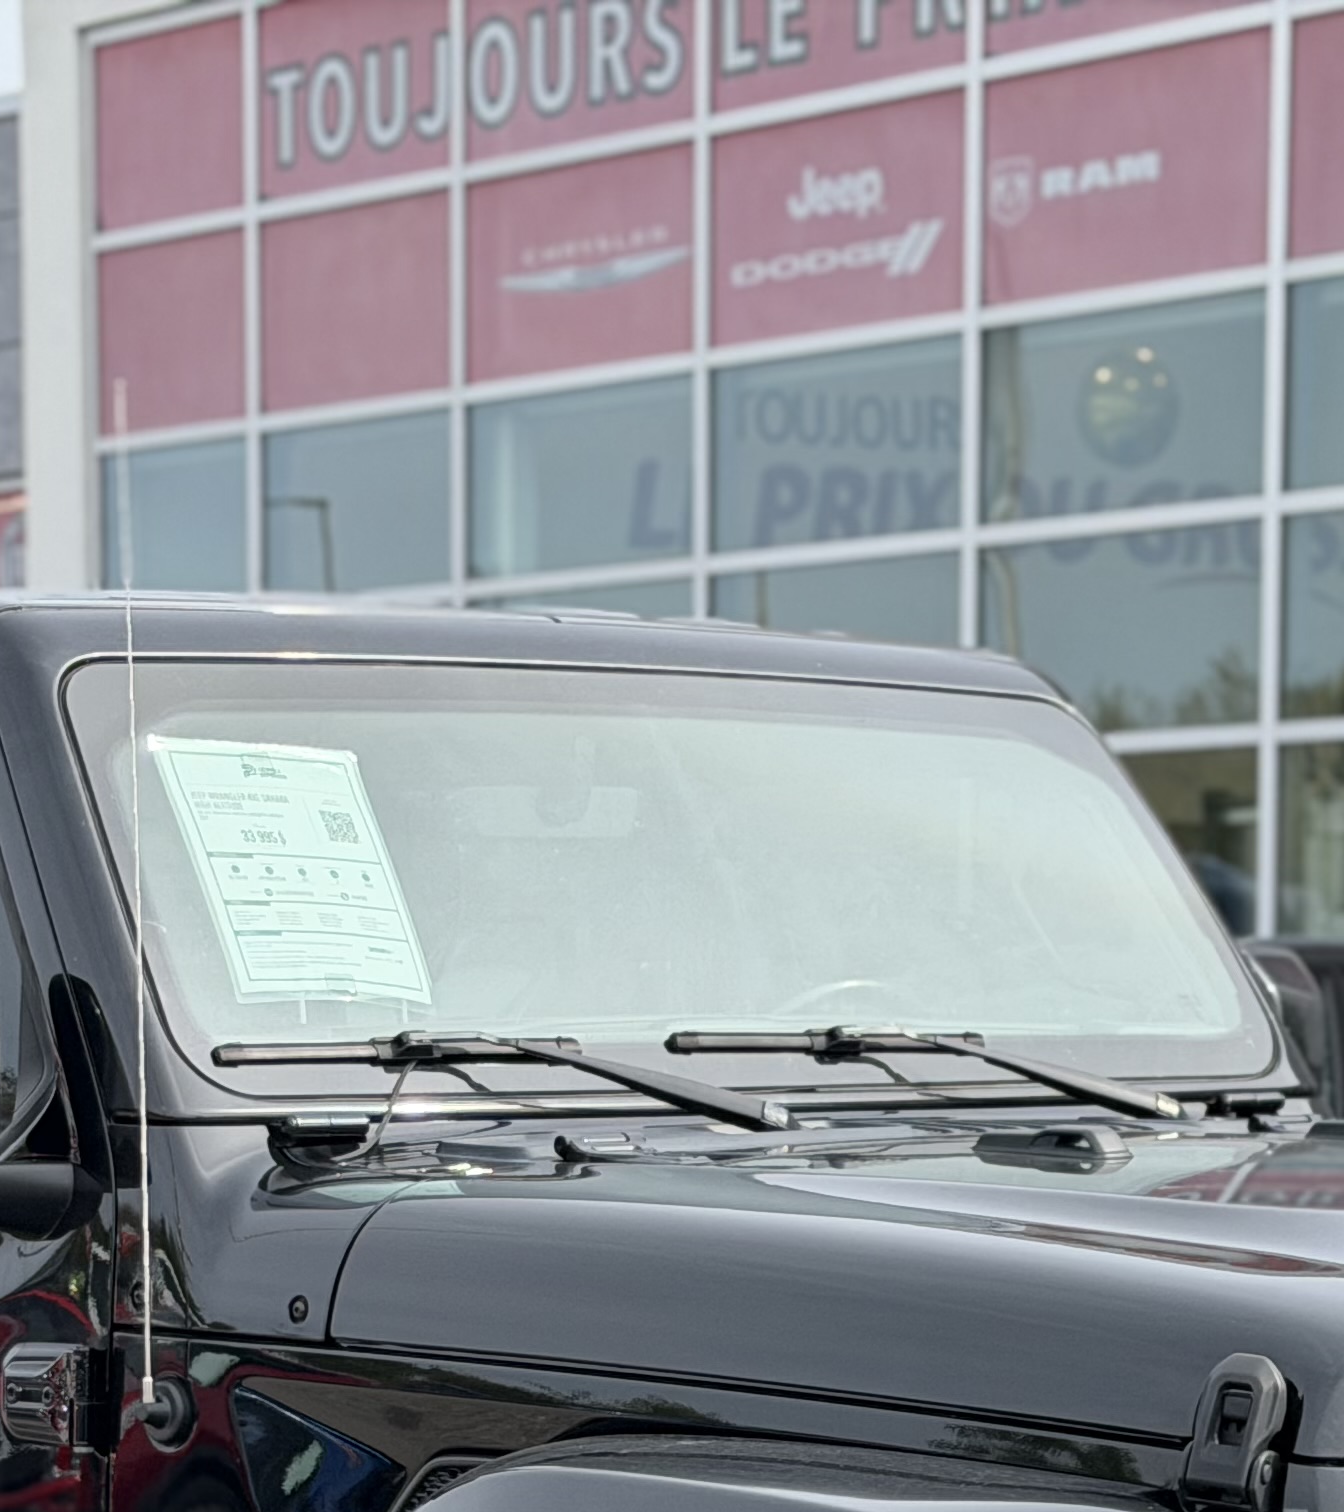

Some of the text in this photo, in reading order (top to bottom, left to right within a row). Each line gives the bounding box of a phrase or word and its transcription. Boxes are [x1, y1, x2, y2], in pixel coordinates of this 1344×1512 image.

[266, 0, 685, 169] TOUJOURS
[785, 165, 884, 220] Jeep
[1040, 149, 1160, 199] RAM
[730, 231, 901, 288] DODGE
[733, 387, 960, 453] TOUJOUR
[630, 455, 690, 548] L
